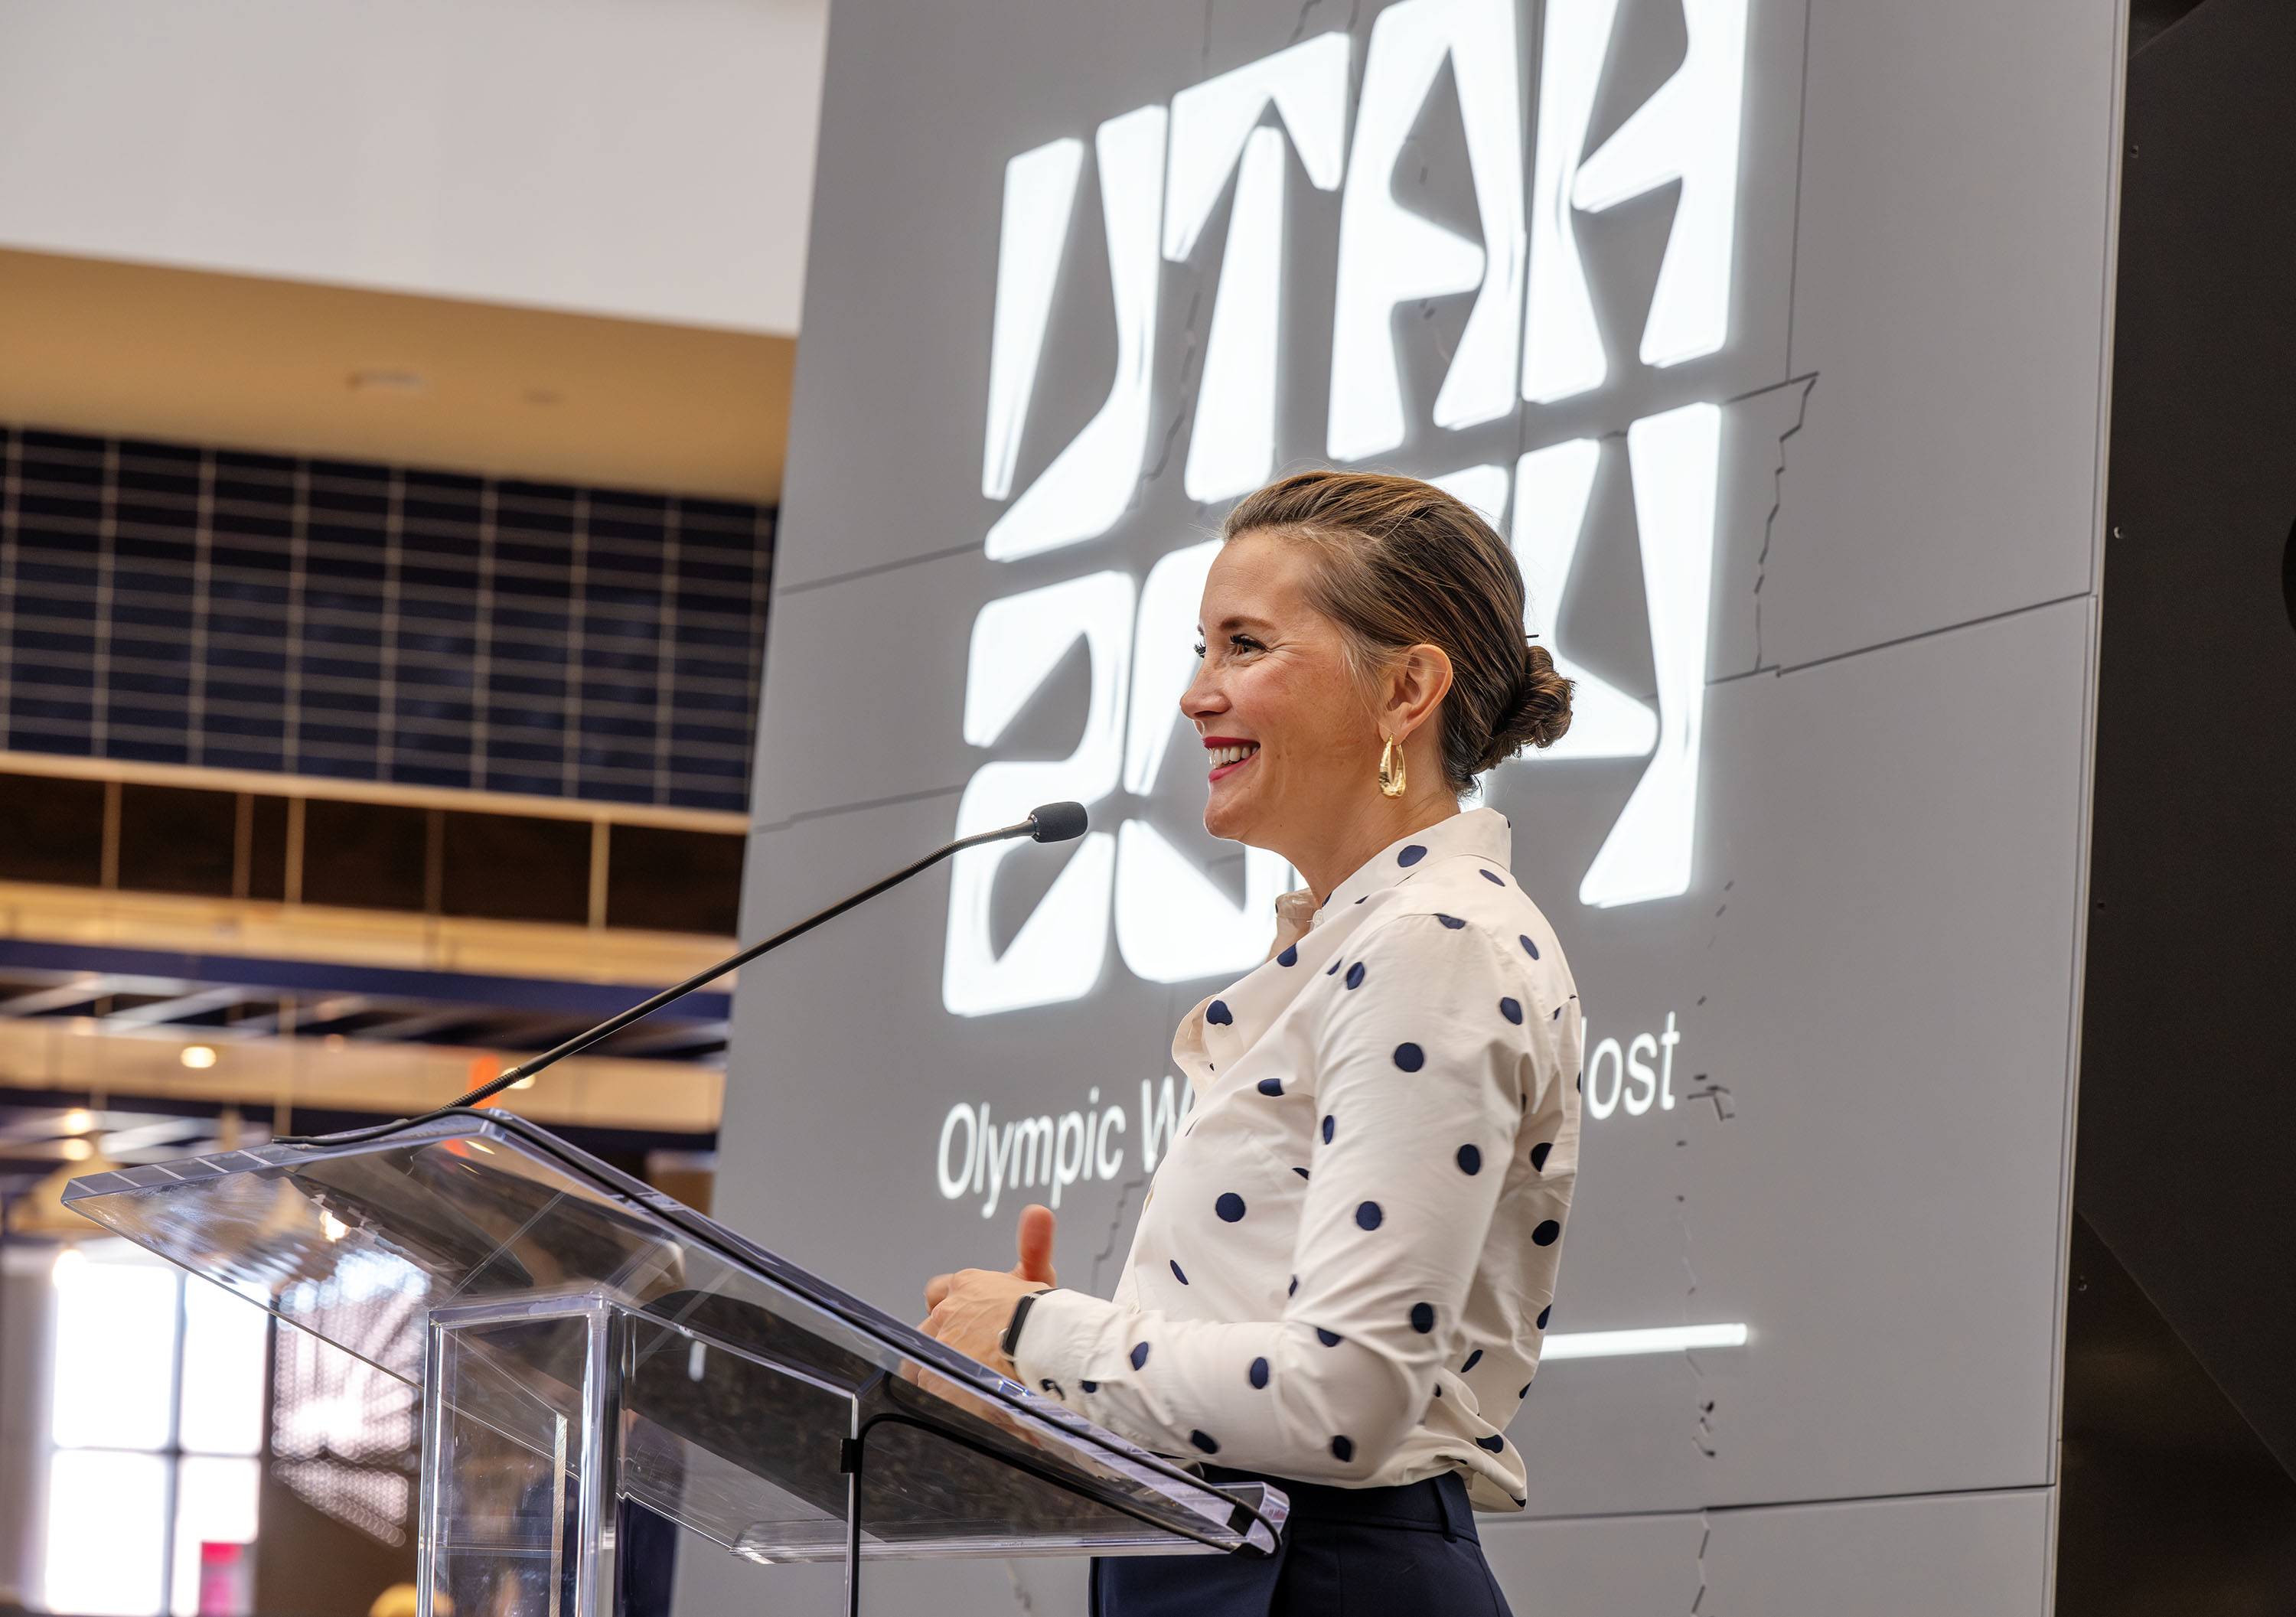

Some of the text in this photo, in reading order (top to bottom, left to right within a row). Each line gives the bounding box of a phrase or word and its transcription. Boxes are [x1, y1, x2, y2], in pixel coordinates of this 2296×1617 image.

[983, 0, 1749, 562] UTAH
[942, 400, 1721, 1019] 204
[938, 1086, 1127, 1219] Olympic
[1580, 1011, 1681, 1120] ost
